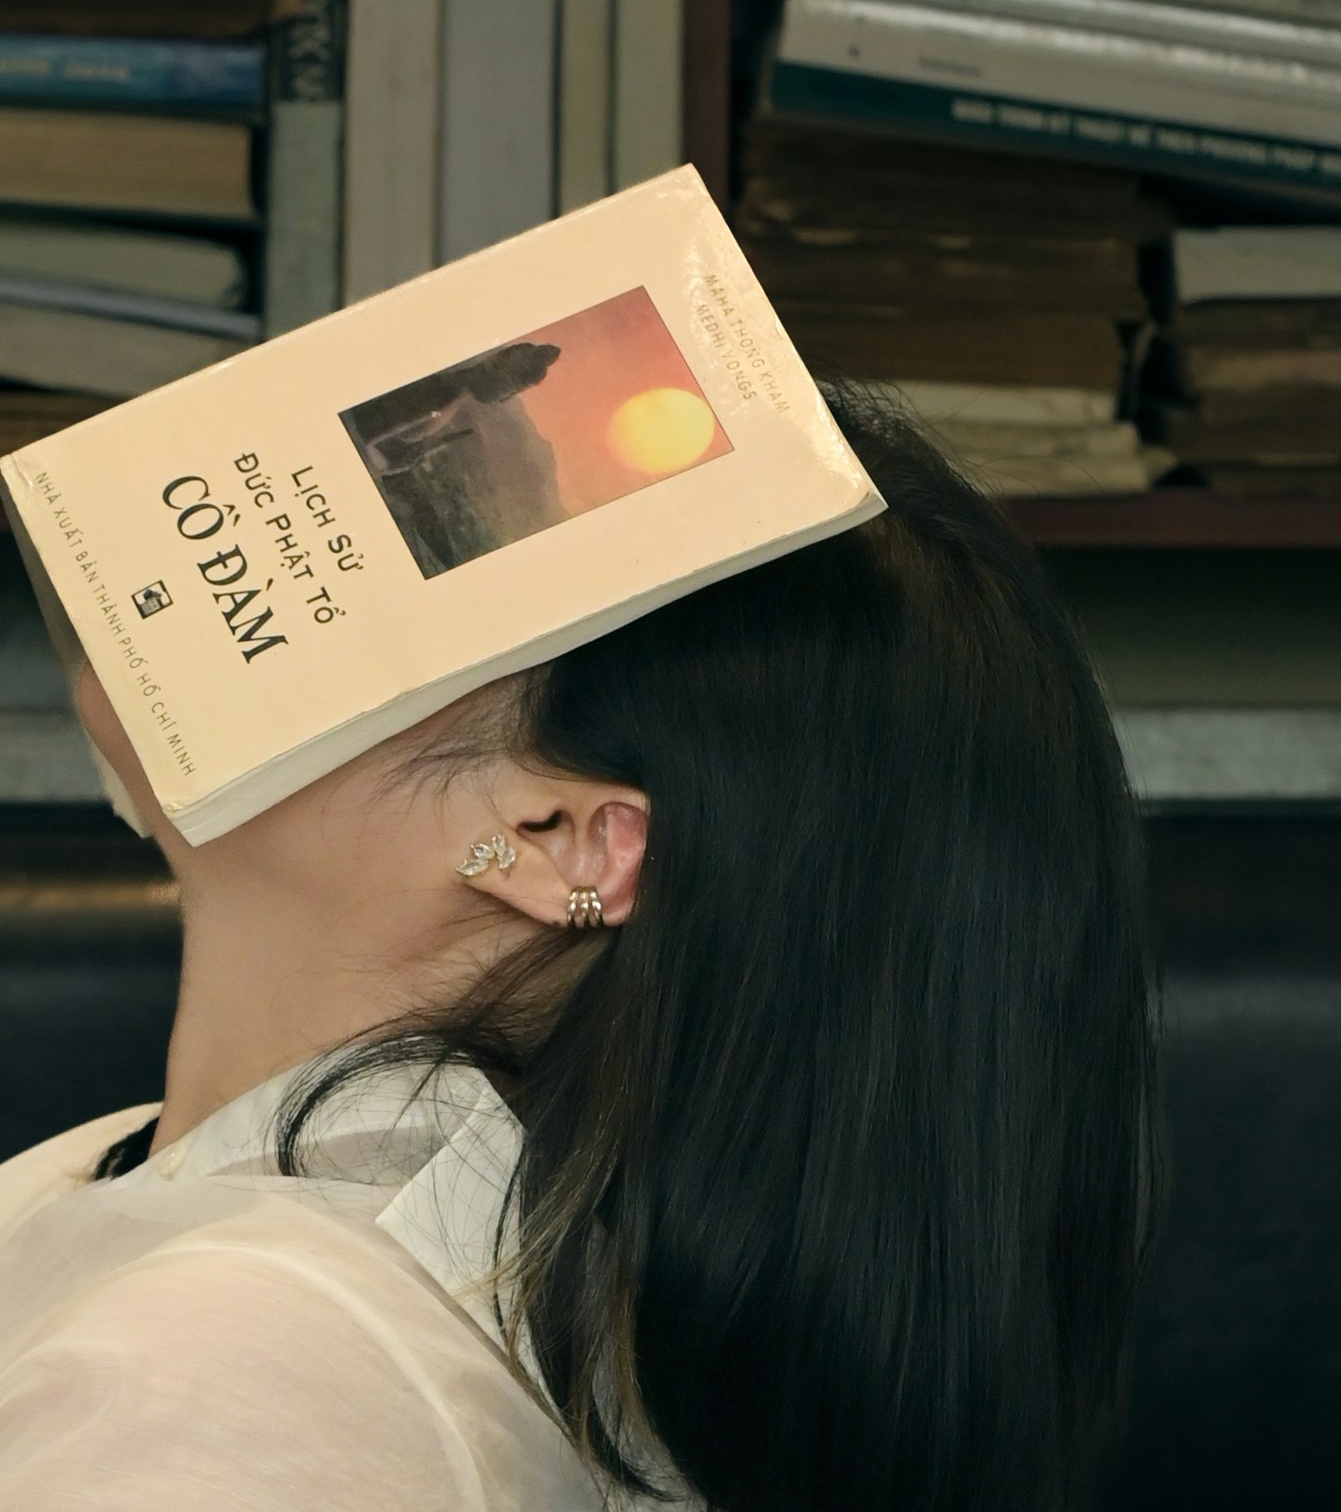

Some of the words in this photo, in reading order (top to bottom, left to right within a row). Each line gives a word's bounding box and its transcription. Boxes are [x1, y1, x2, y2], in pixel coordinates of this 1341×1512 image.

[703, 273, 736, 318] MAHA
[728, 317, 766, 369] THONG
[758, 370, 791, 414] KHAM
[161, 475, 241, 541] CỒ
[232, 451, 275, 509] ĐỨC
[264, 512, 315, 580] PHẬT
[305, 585, 347, 625] TỔ
[290, 465, 337, 529] LỊCH
[326, 533, 365, 572] SỬ
[35, 471, 62, 505] NHÀ
[52, 506, 85, 548] XUẤT
[74, 550, 100, 584] BẢN
[93, 583, 126, 637] THÀNH
[117, 636, 150, 670] PHỐ
[136, 672, 162, 698] HỒ
[150, 701, 178, 732] CHÍ
[166, 732, 197, 777] MINH
[195, 543, 290, 665] ĐÀM
